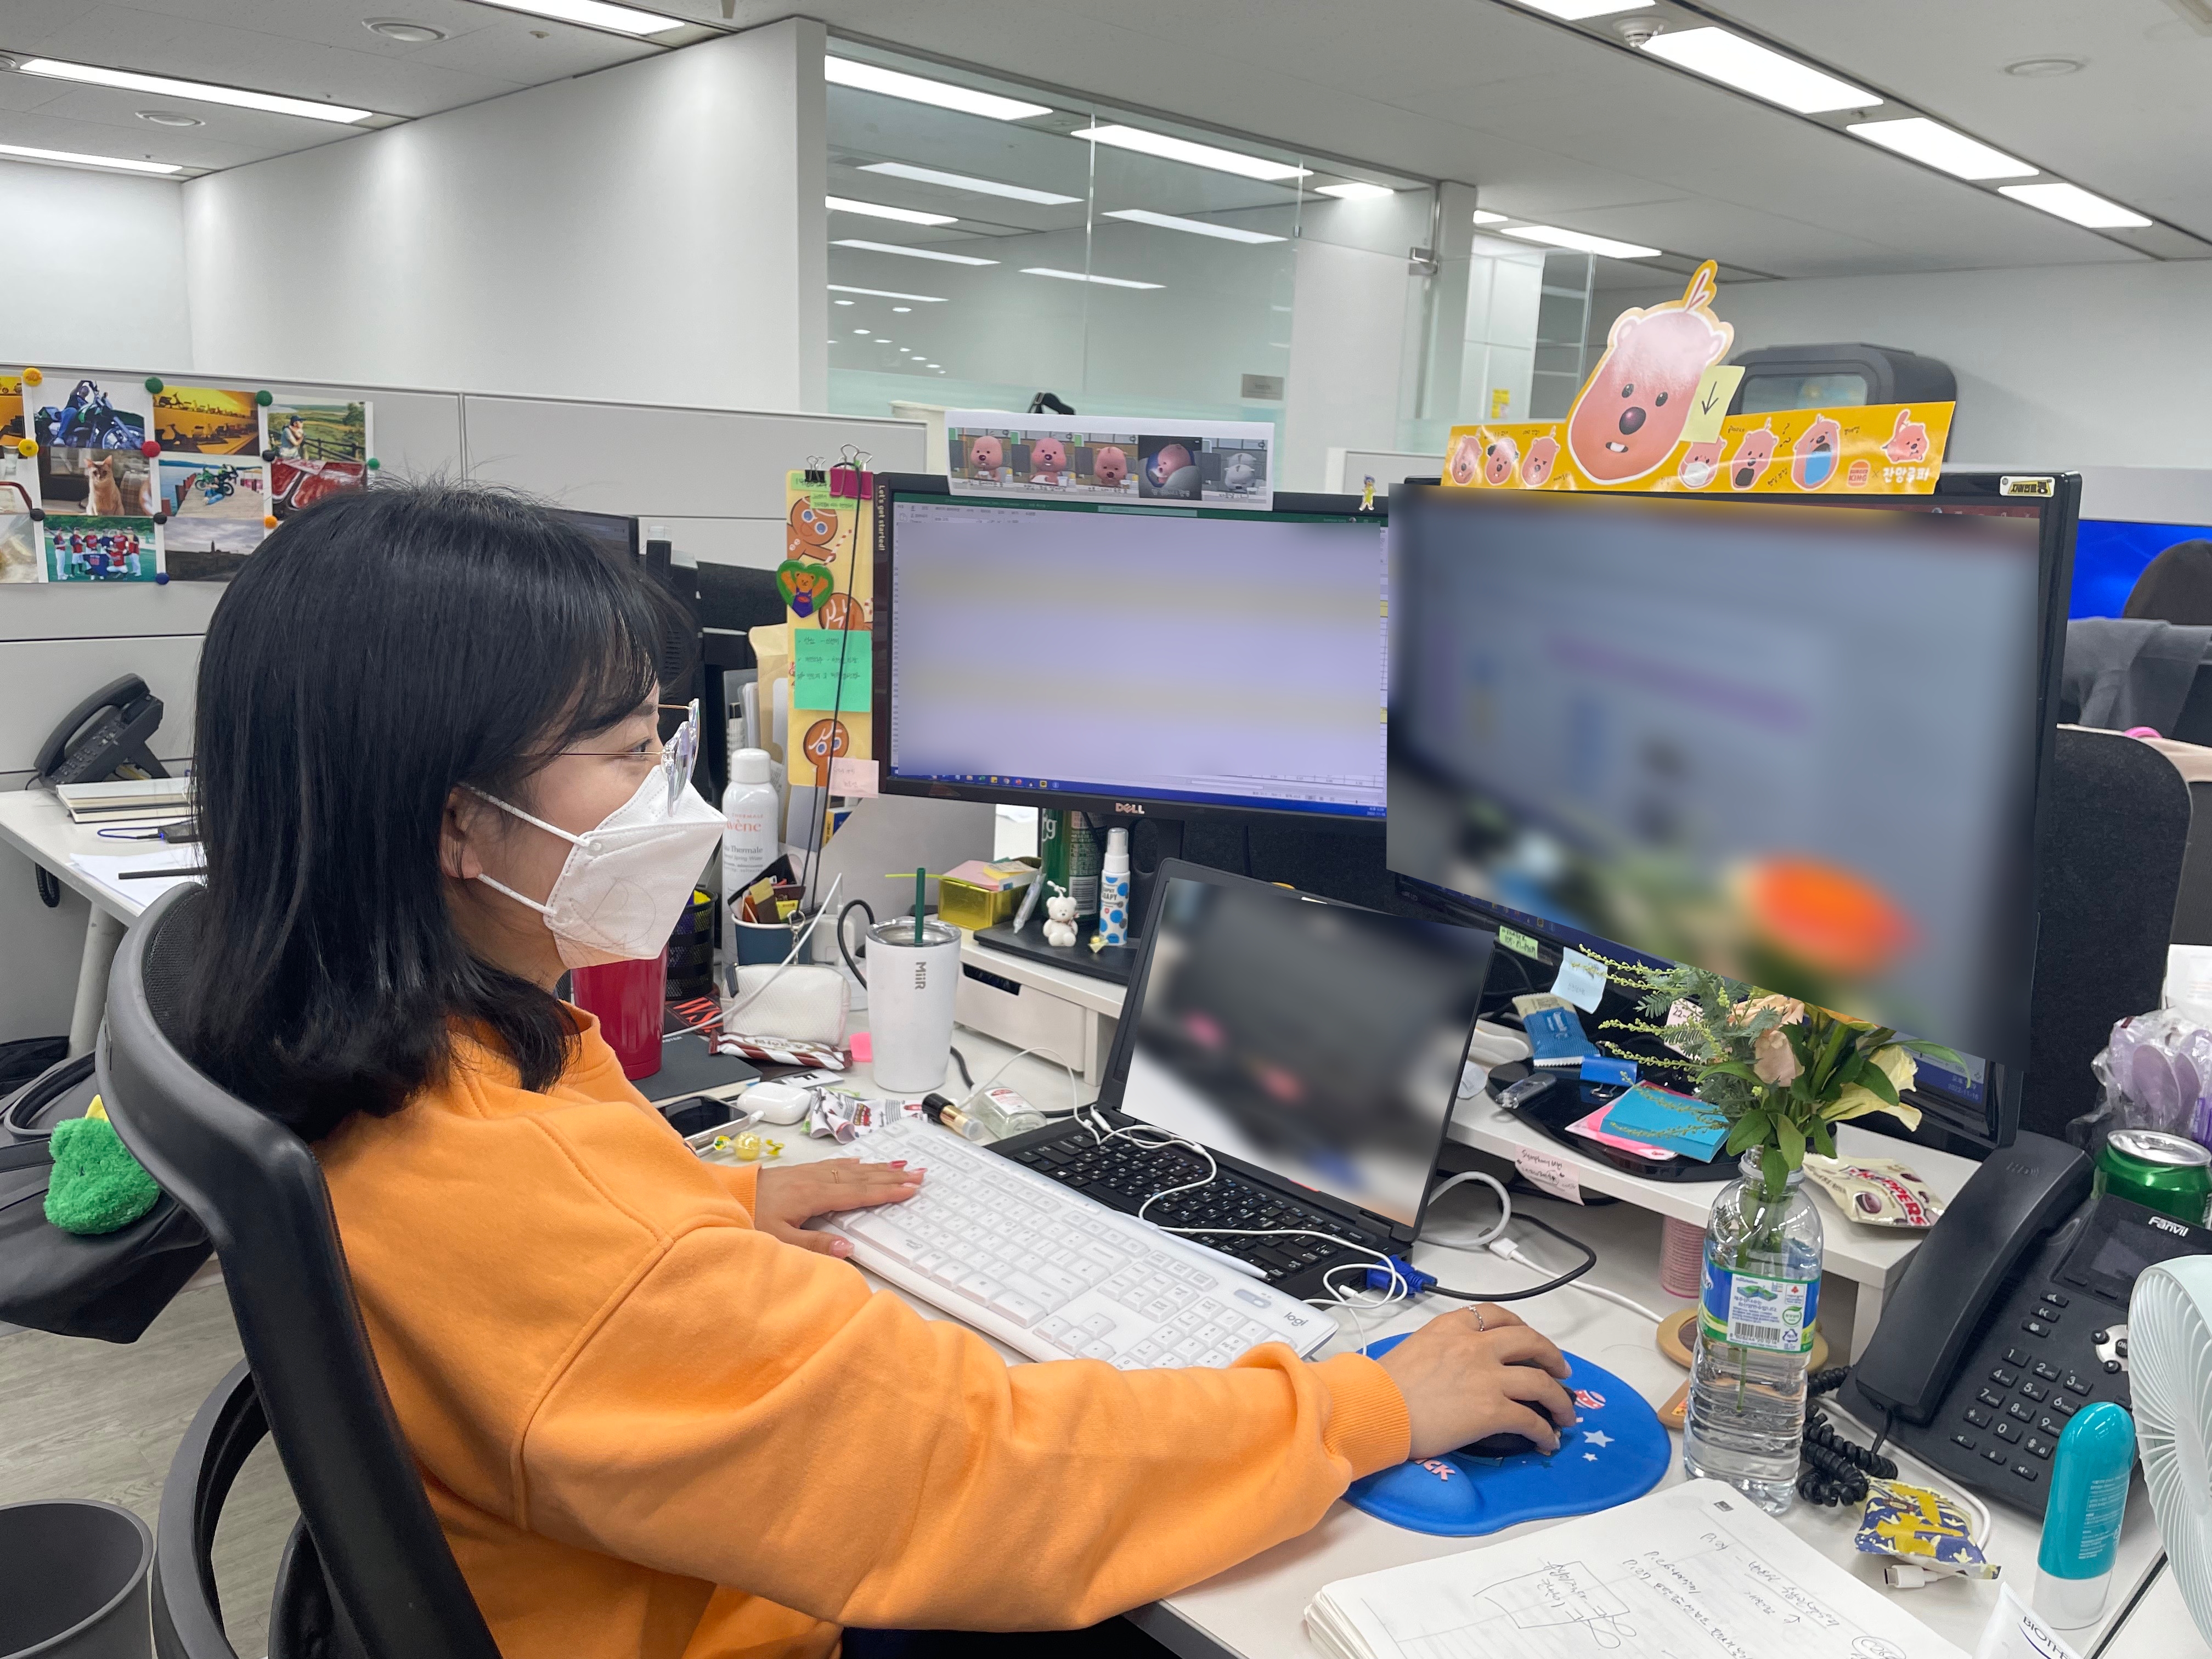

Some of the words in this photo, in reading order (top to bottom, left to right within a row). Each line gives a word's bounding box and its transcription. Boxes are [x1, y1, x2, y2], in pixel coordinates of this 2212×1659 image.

[878, 485, 887, 504] Let's
[878, 520, 886, 551] started!
[1115, 803, 1145, 814] DELL
[915, 961, 927, 990] MiiR
[2148, 1215, 2190, 1237] Fanvil
[1284, 1311, 1309, 1327] logi
[2007, 1348, 2015, 1359] 1
[2036, 1362, 2046, 1373] 2
[1993, 1369, 2003, 1379] 4
[2066, 1375, 2076, 1386] 3
[1979, 1388, 1990, 1398] 7
[2023, 1382, 2034, 1393] 5
[2011, 1402, 2021, 1413] 8
[2053, 1397, 2063, 1407] 6
[2041, 1417, 2051, 1427] 9
[1997, 1423, 2008, 1434] 0
